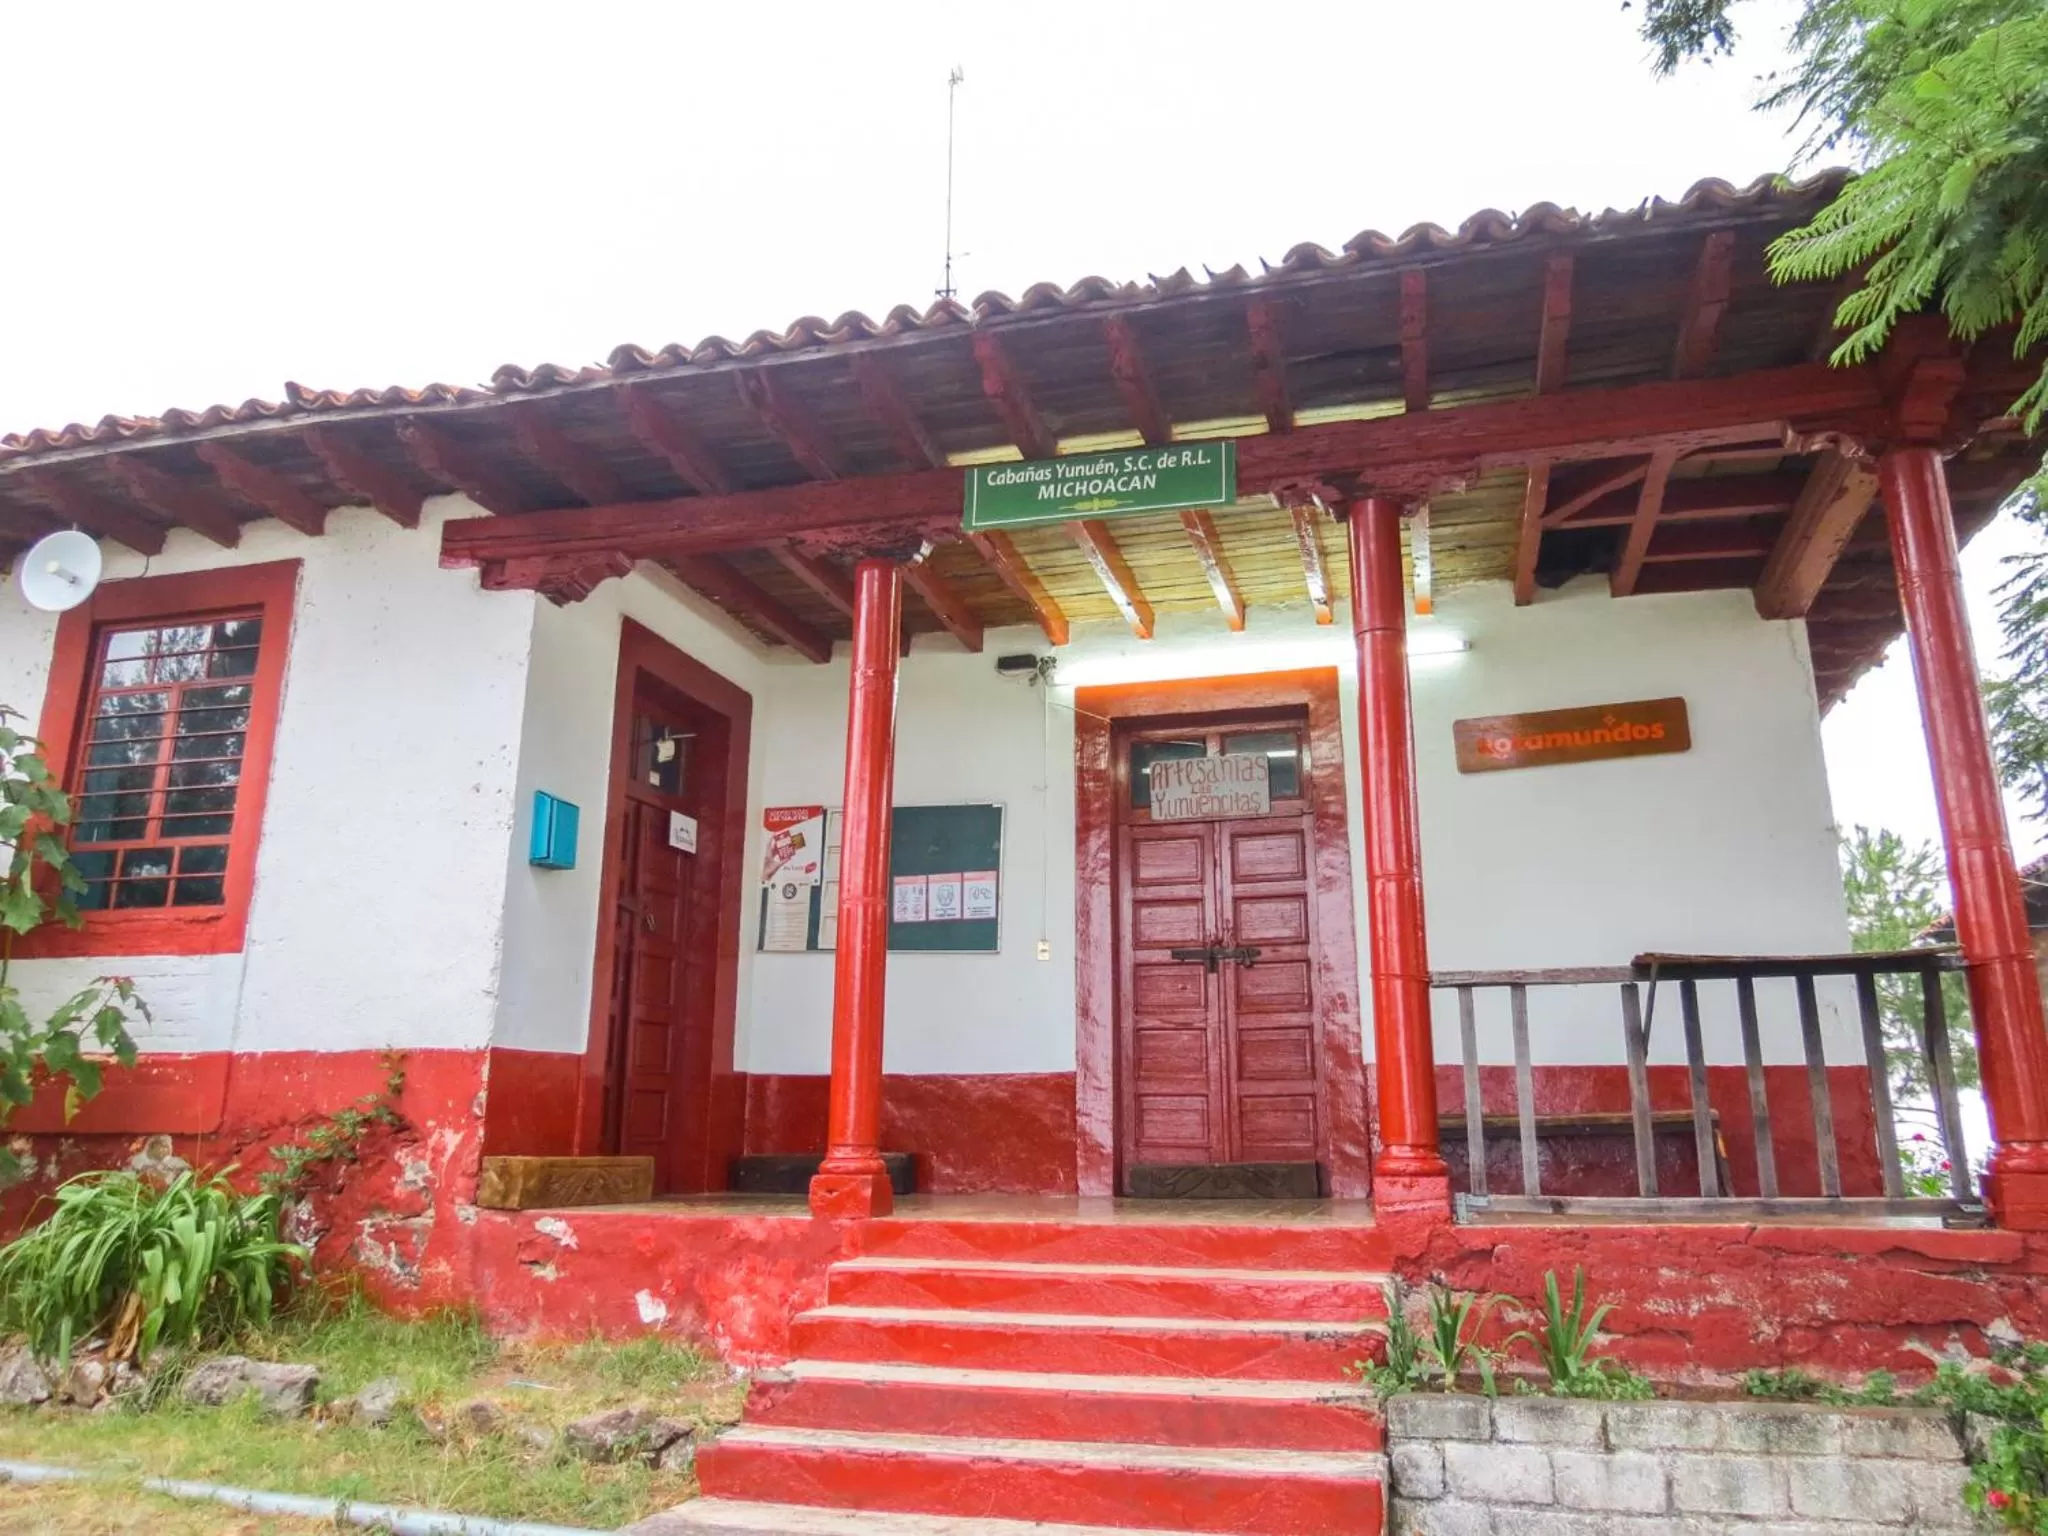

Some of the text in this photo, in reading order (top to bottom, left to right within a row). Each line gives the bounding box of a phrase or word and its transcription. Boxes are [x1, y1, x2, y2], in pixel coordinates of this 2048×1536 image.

[986, 449, 1212, 487] Cabañas Yunuén, S.C. de R.L.
[1037, 475, 1156, 501] MICHOACAN
